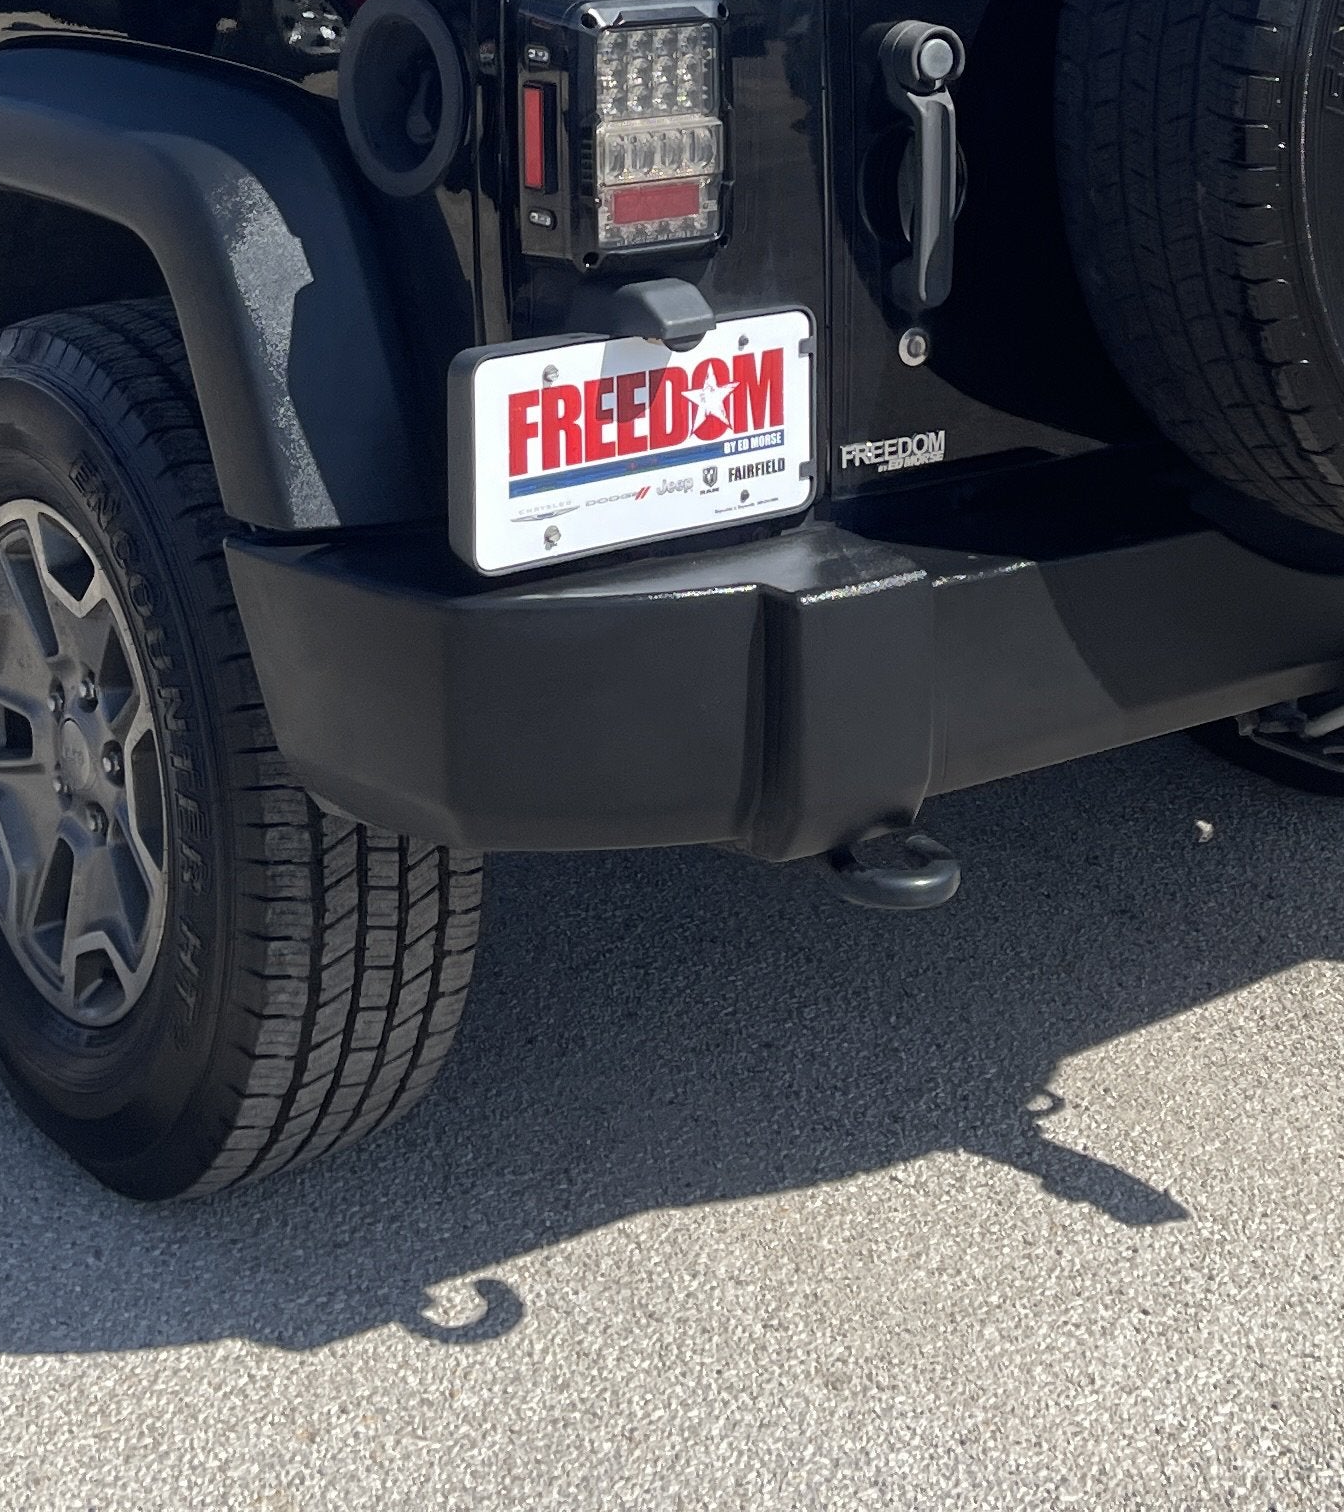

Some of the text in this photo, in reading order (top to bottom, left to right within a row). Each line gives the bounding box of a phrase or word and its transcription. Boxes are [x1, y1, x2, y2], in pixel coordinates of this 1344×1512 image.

[508, 348, 785, 477] FREEDOM
[724, 432, 782, 454] BY ED MORSE
[840, 430, 946, 469] FREEDOM
[728, 457, 785, 483] FAIRFIELD
[888, 458, 904, 471] ED
[904, 452, 944, 468] MORSE
[656, 477, 694, 496] Jeep
[69, 455, 212, 896] ENCOUNTER
